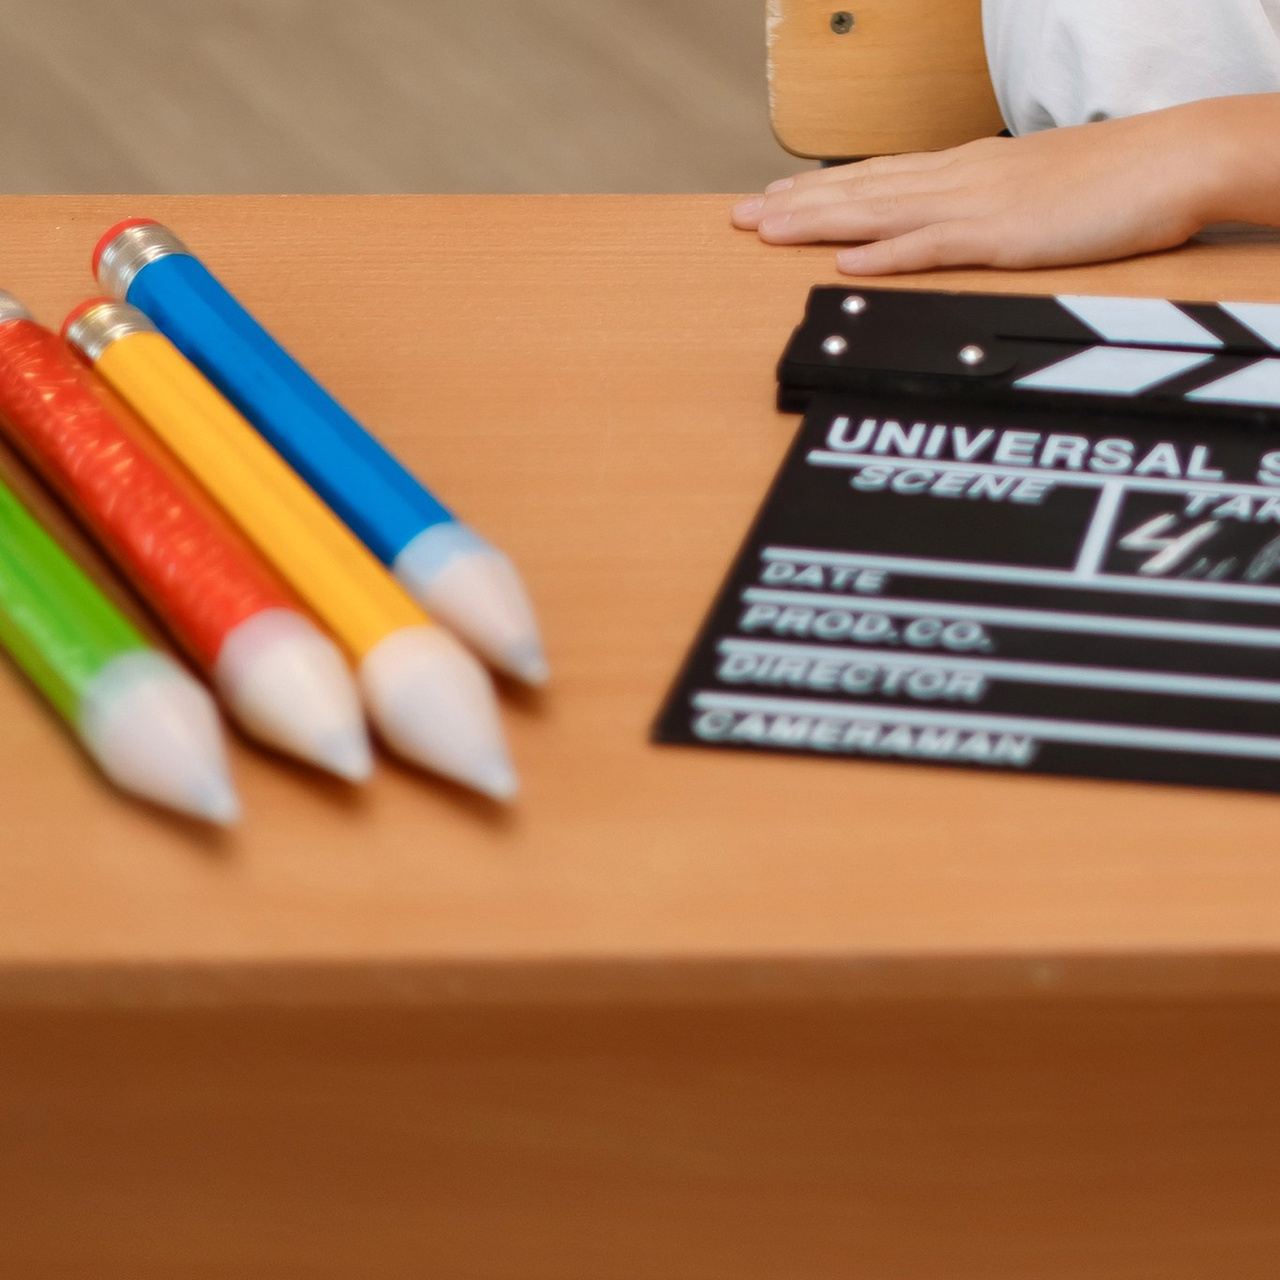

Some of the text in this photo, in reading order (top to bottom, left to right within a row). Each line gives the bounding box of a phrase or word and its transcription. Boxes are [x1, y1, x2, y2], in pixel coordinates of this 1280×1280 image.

[826, 416, 1224, 482] UNIVERSAL
[850, 465, 1055, 504] SCENE
[761, 561, 887, 593] DATE
[716, 650, 987, 703] DIRECTOR
[691, 708, 1037, 767] CAMERAMAN
